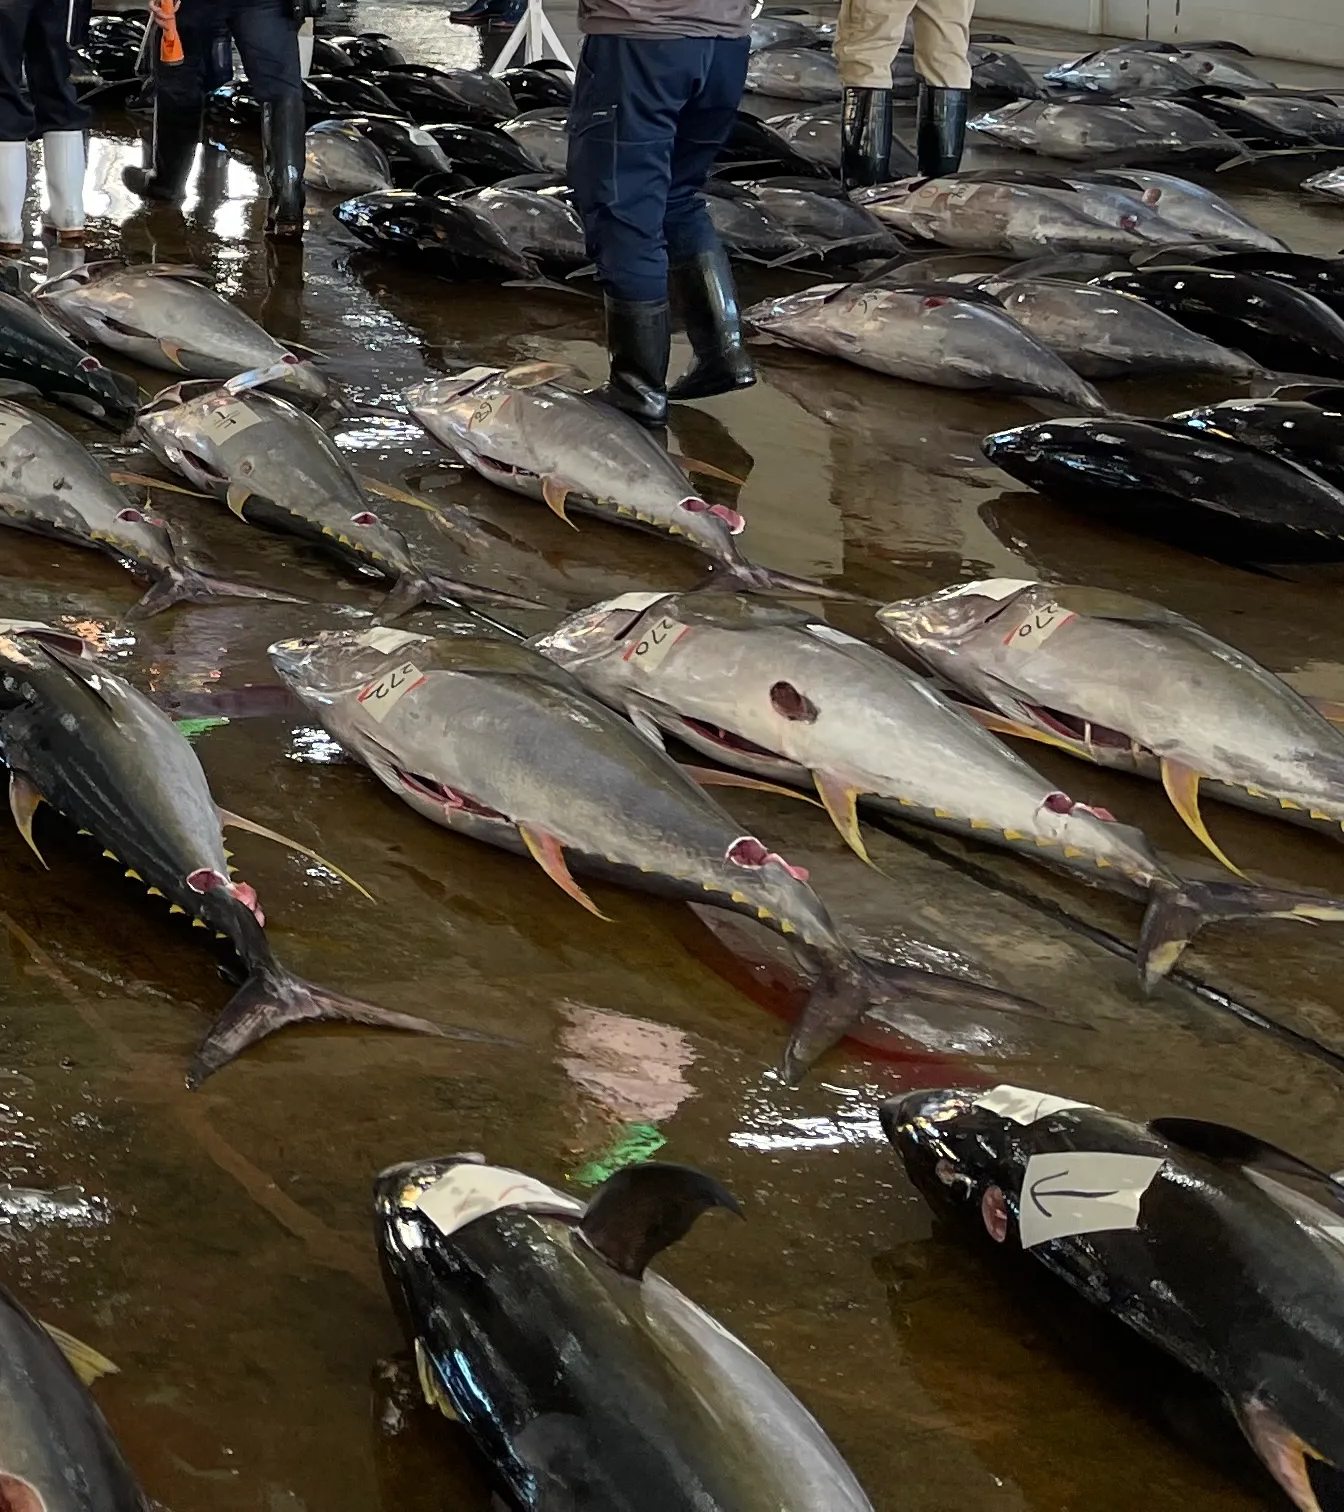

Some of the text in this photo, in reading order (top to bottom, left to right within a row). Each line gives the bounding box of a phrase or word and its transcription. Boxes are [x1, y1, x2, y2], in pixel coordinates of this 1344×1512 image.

[635, 619, 674, 656] 270
[1018, 605, 1058, 639] 270
[364, 660, 415, 699] 272
